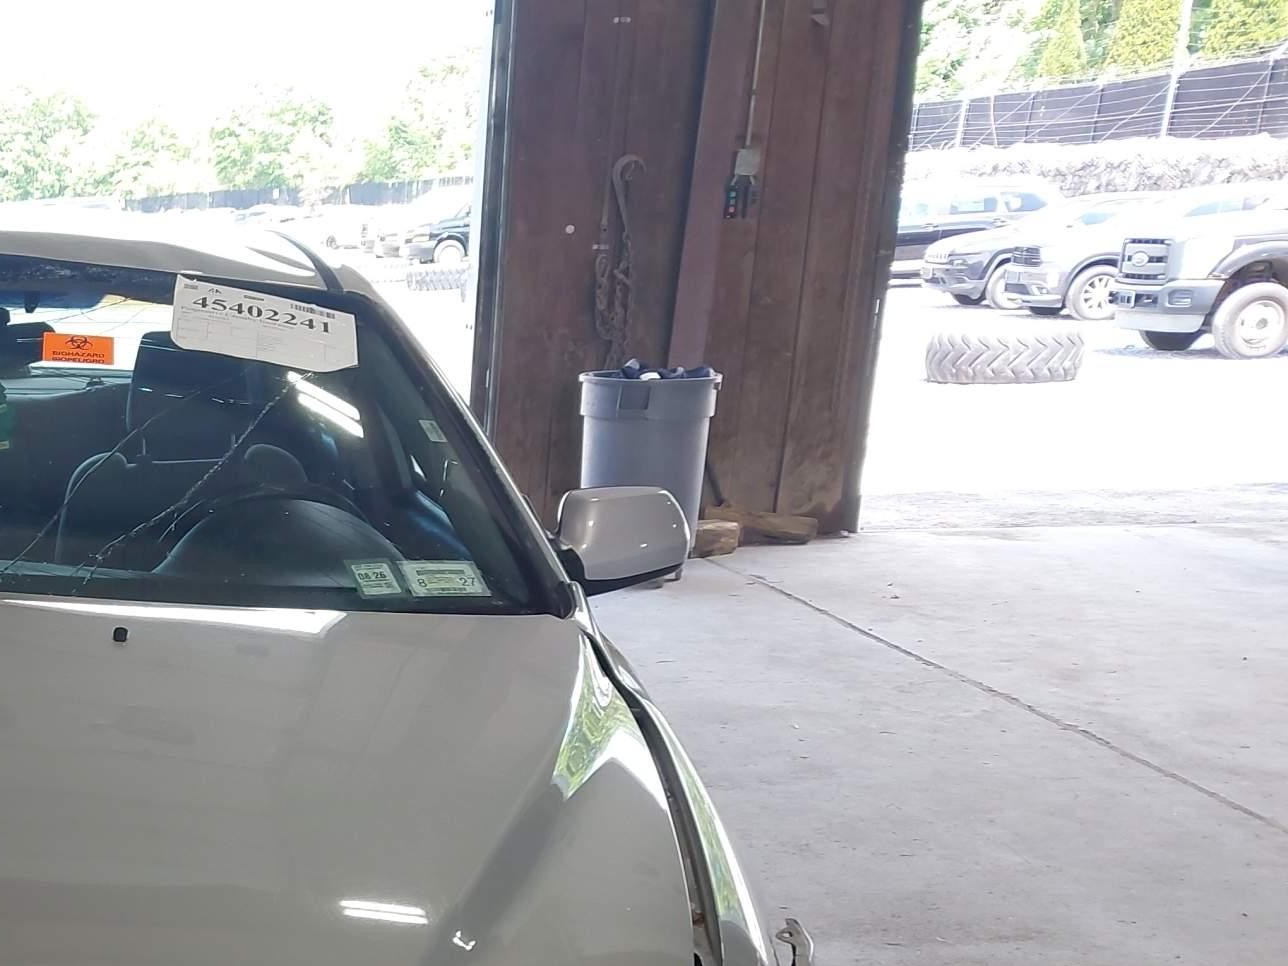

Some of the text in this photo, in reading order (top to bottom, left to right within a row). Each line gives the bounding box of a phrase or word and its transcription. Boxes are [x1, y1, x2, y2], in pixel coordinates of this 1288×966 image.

[192, 296, 331, 333] 45402241
[52, 350, 105, 358] BIOHAZARD
[458, 577, 475, 587] 27
